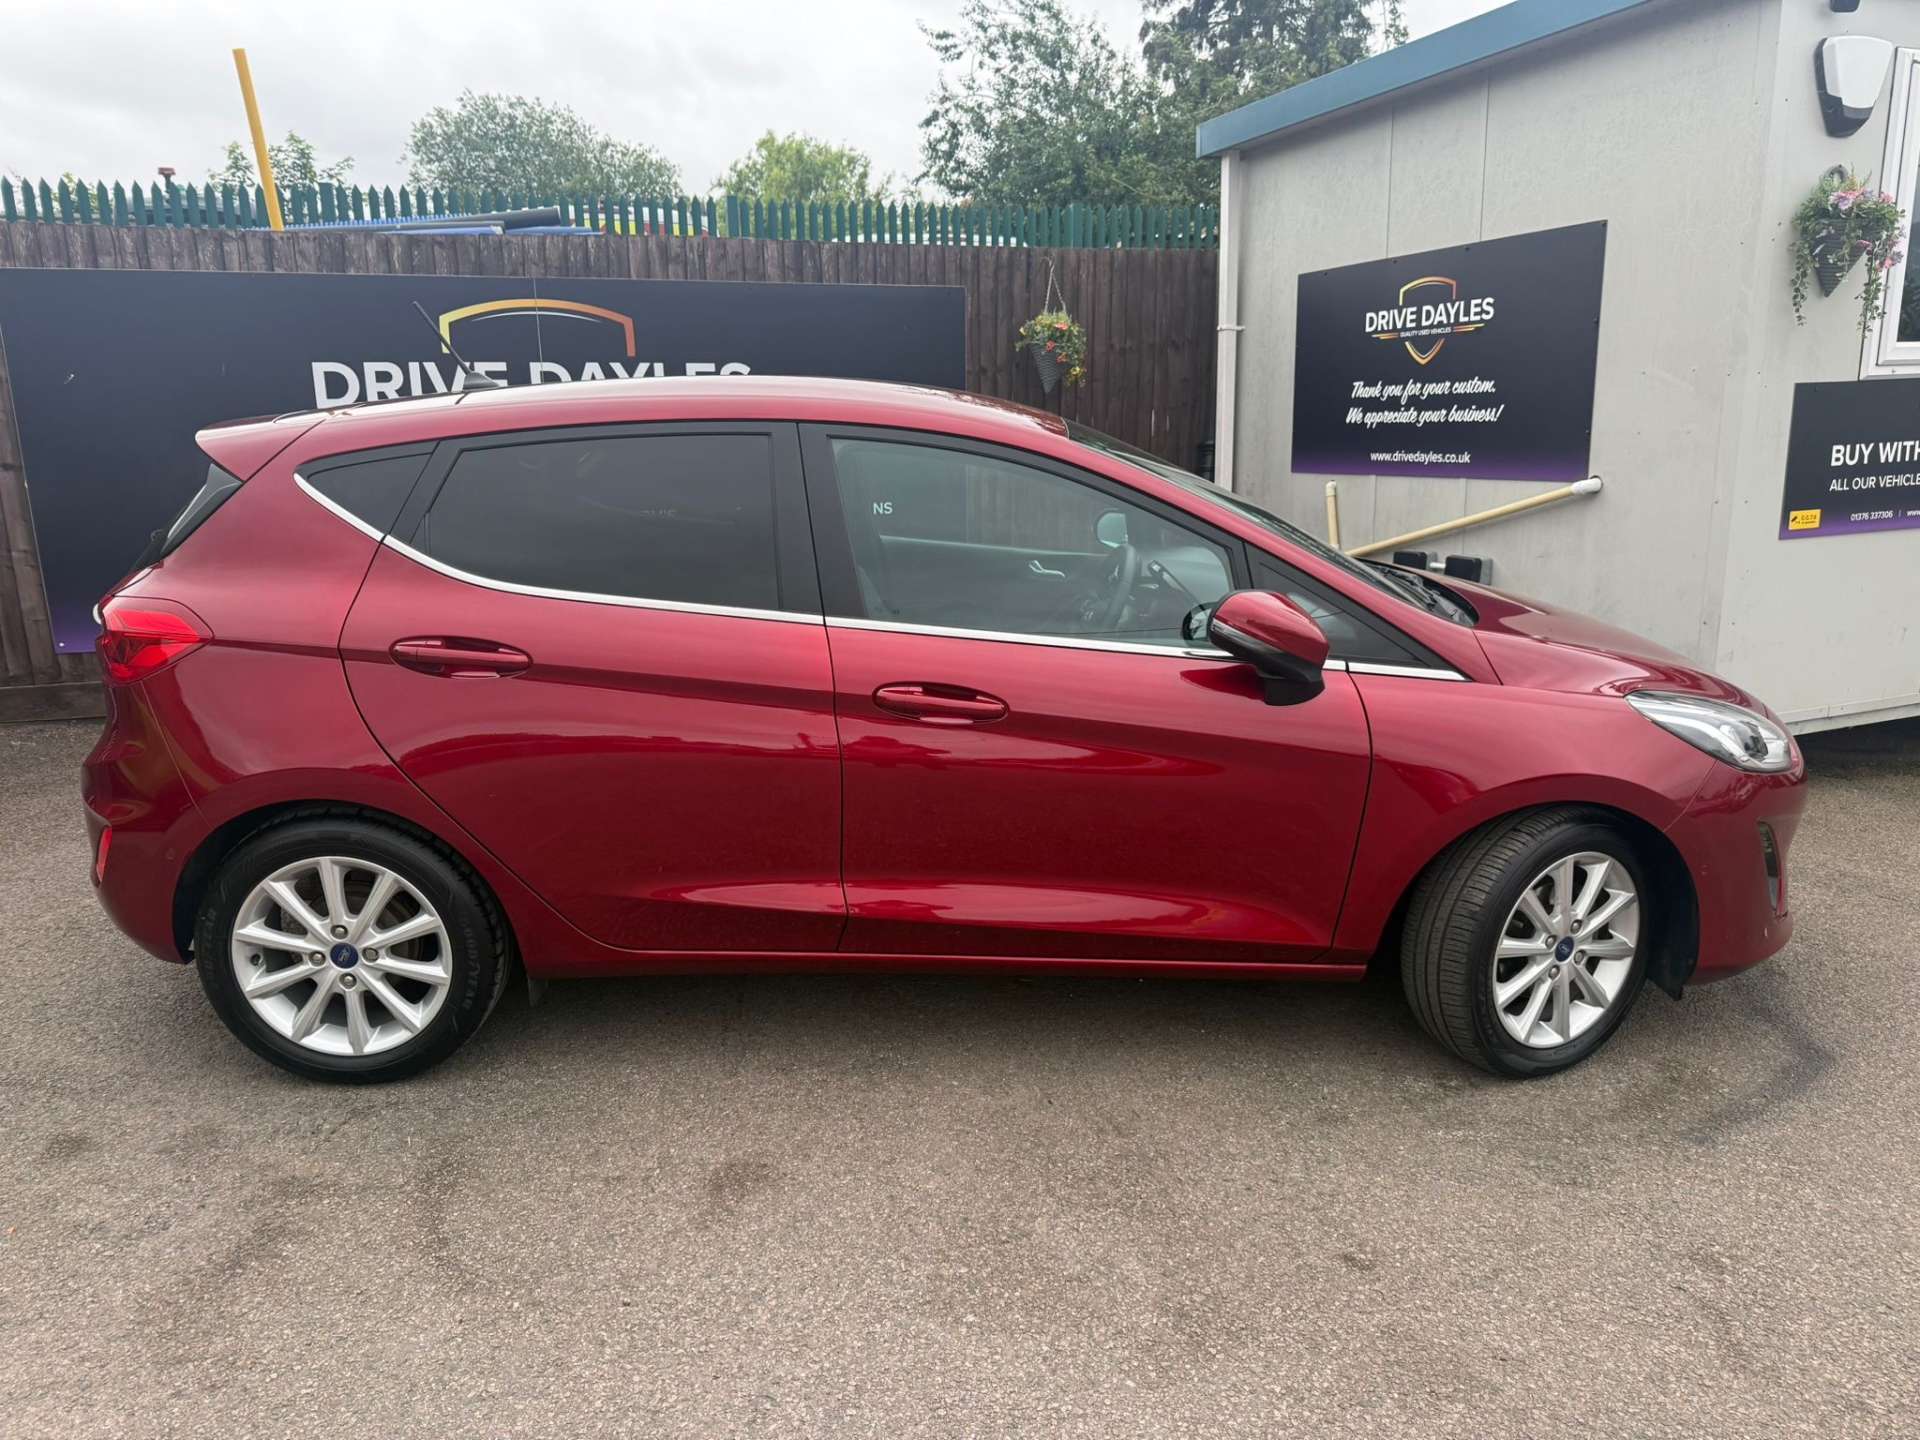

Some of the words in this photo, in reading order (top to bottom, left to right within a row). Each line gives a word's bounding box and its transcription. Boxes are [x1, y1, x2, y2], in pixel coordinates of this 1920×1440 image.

[1365, 306, 1418, 332] DRIVE
[1421, 297, 1495, 327] DAYLES
[1351, 381, 1382, 399] Thank
[1380, 384, 1403, 401] you
[1401, 378, 1422, 405] for
[1420, 381, 1451, 399] your
[1452, 376, 1496, 394] custom.
[1345, 407, 1363, 424] We
[1363, 406, 1418, 429] appreciate
[1416, 408, 1447, 427] your
[1448, 404, 1505, 422] business!
[1370, 450, 1471, 465] www.drivedayles.co.uk
[1830, 443, 1874, 467] BUY
[1829, 478, 1849, 491] ALL
[1852, 476, 1876, 490] OUR
[1878, 473, 1920, 487] VEHICLE
[873, 502, 893, 515] NS
